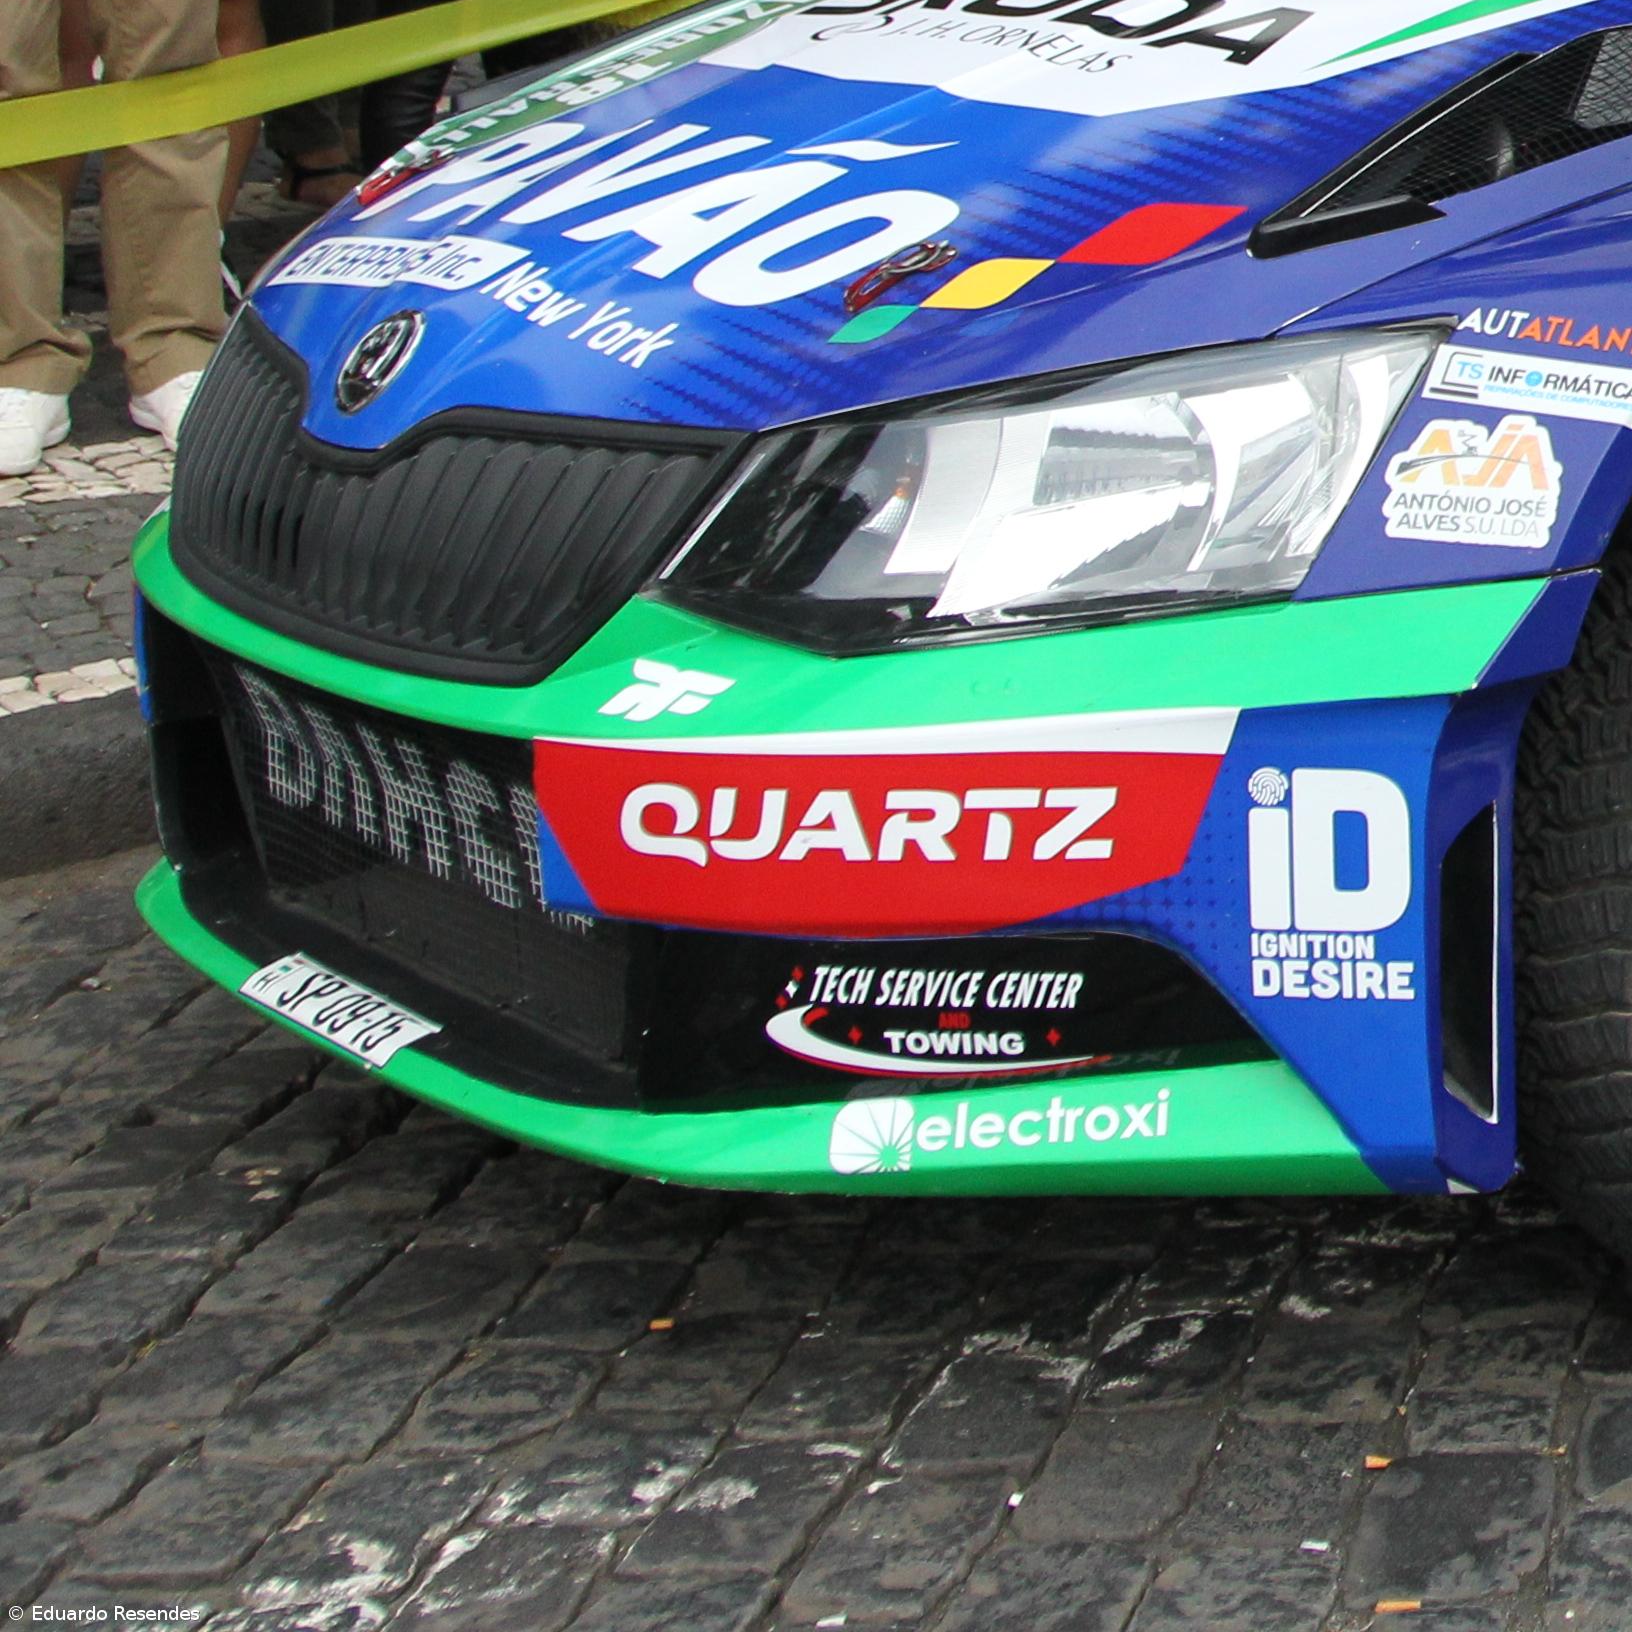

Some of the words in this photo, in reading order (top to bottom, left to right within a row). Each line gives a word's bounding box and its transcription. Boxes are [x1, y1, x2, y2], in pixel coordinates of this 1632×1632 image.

[958, 22, 1133, 73] ORNELAS
[350, 119, 961, 308] PAVÃO
[480, 262, 586, 328] New
[568, 301, 680, 369] York
[1456, 360, 1484, 381] TS
[1392, 489, 1491, 515] ANTÓNIO
[1493, 495, 1548, 519] JOSÉ
[1395, 511, 1461, 532] ALVES
[1461, 516, 1498, 536] S.U.
[1500, 518, 1540, 539] LDA
[620, 783, 1118, 867] QUARTZ
[1251, 933, 1375, 960] IGNITION
[808, 965, 873, 1005] TECH
[874, 968, 986, 1008] SERVICE
[986, 972, 1084, 1010] CENTER
[1252, 959, 1416, 1000] DESIRE
[938, 1011, 971, 1029] AND
[883, 1031, 1026, 1056] TOWING
[916, 1087, 1171, 1153] electroxi
